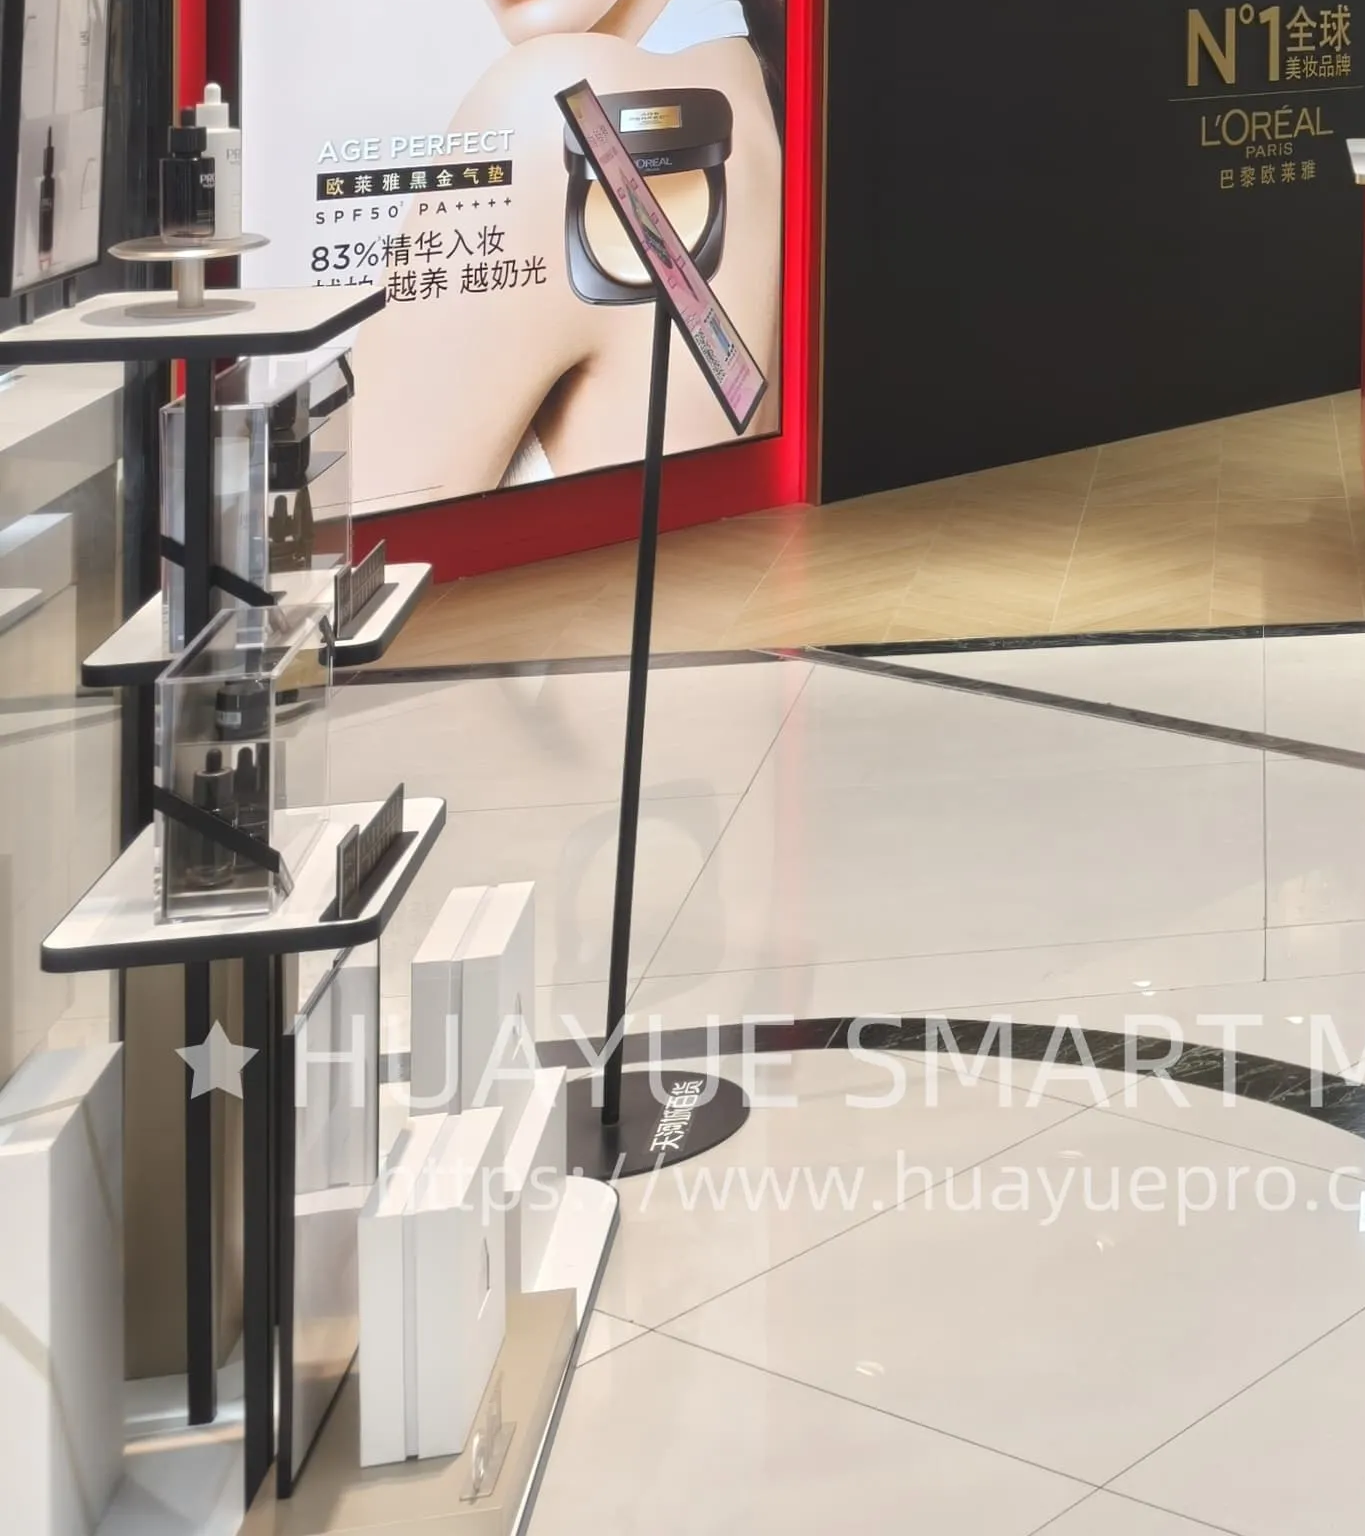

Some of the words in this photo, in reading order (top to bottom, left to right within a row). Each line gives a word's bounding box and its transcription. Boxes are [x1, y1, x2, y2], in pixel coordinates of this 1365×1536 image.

[1285, 53, 1352, 81] 美妆品牌
[1201, 105, 1334, 146] L'ORÉAL
[317, 137, 381, 164] AGE
[391, 128, 515, 159] PERFECT
[1246, 142, 1294, 159] PARiS
[325, 163, 505, 196] 欧莱雅黑金气垫
[1220, 159, 1316, 189] 巴黎欧莱雅
[459, 255, 547, 295] 越奶光
